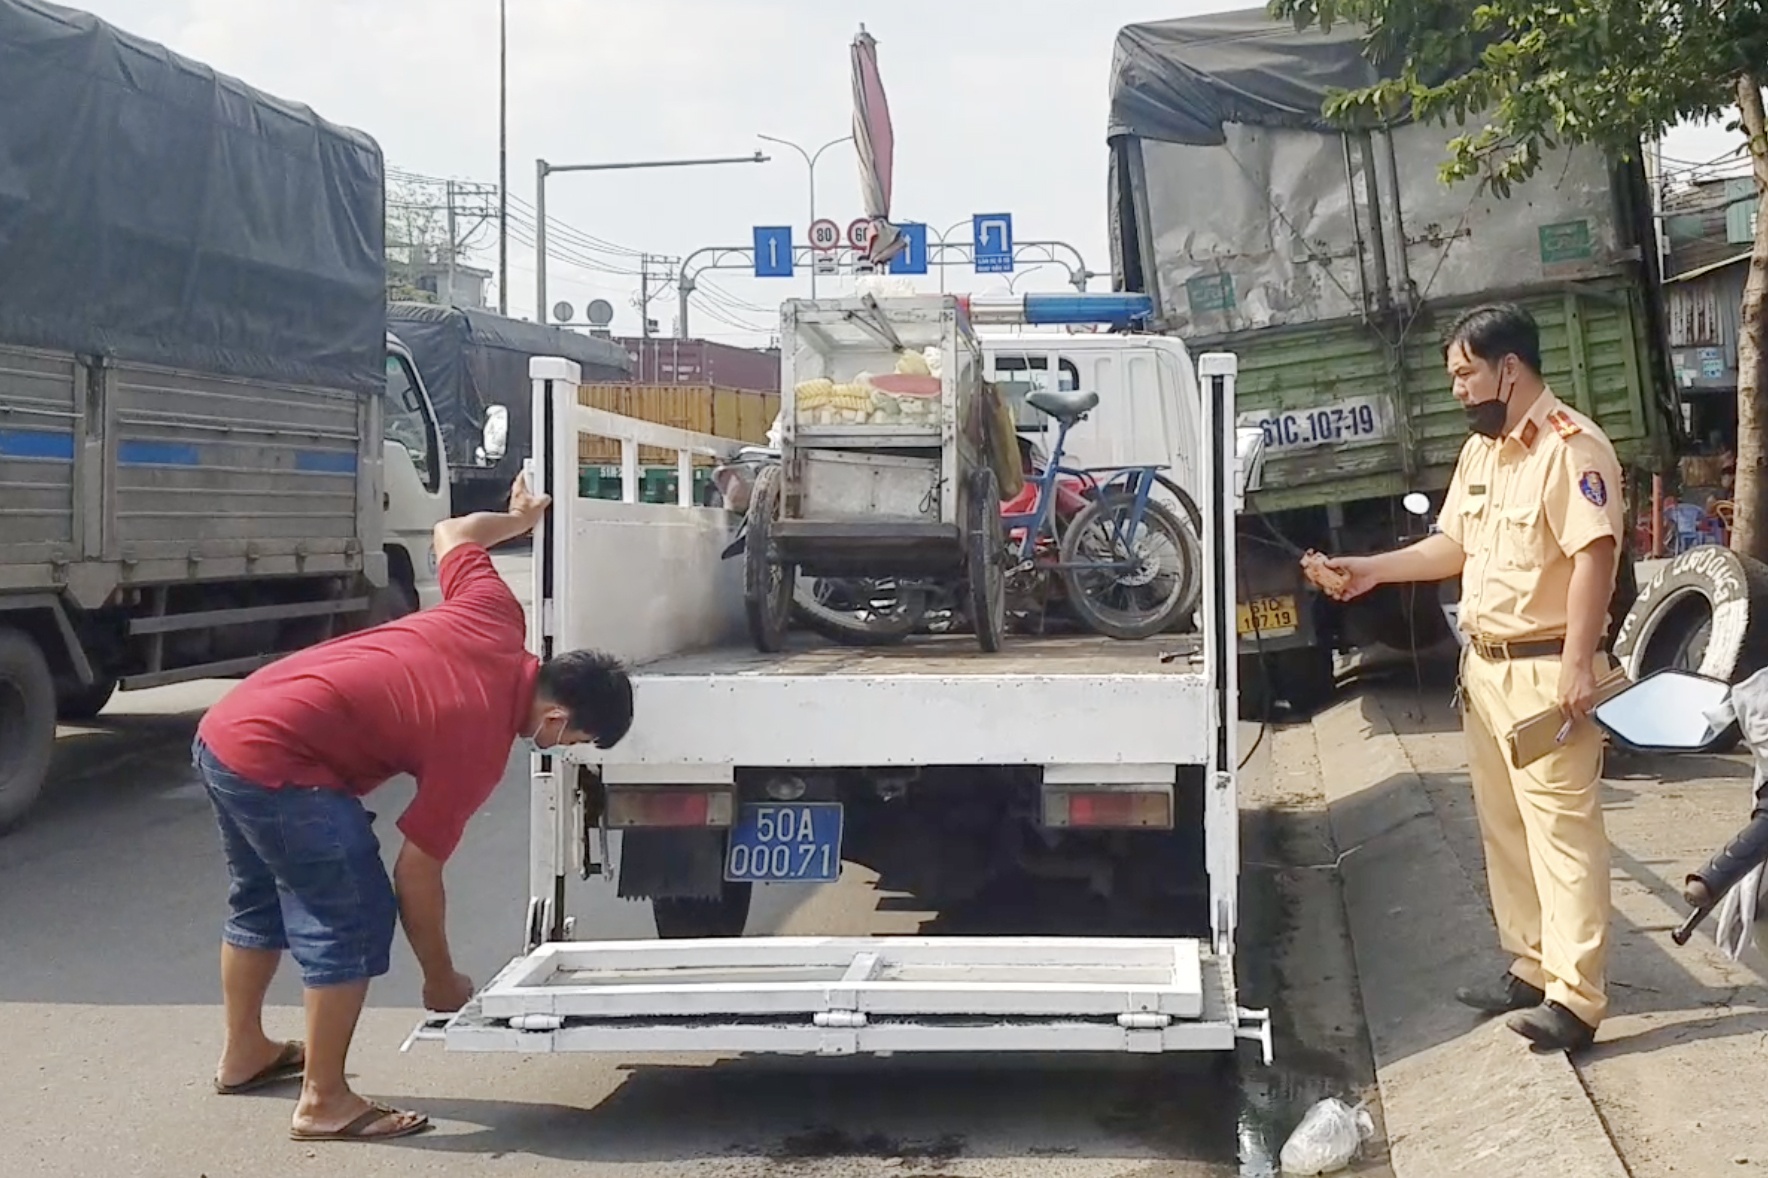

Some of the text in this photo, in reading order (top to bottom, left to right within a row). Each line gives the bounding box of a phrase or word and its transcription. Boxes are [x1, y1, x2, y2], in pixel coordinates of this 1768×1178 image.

[816, 227, 833, 242] 80
[757, 807, 815, 842] 50A
[730, 844, 831, 877] 000.71
